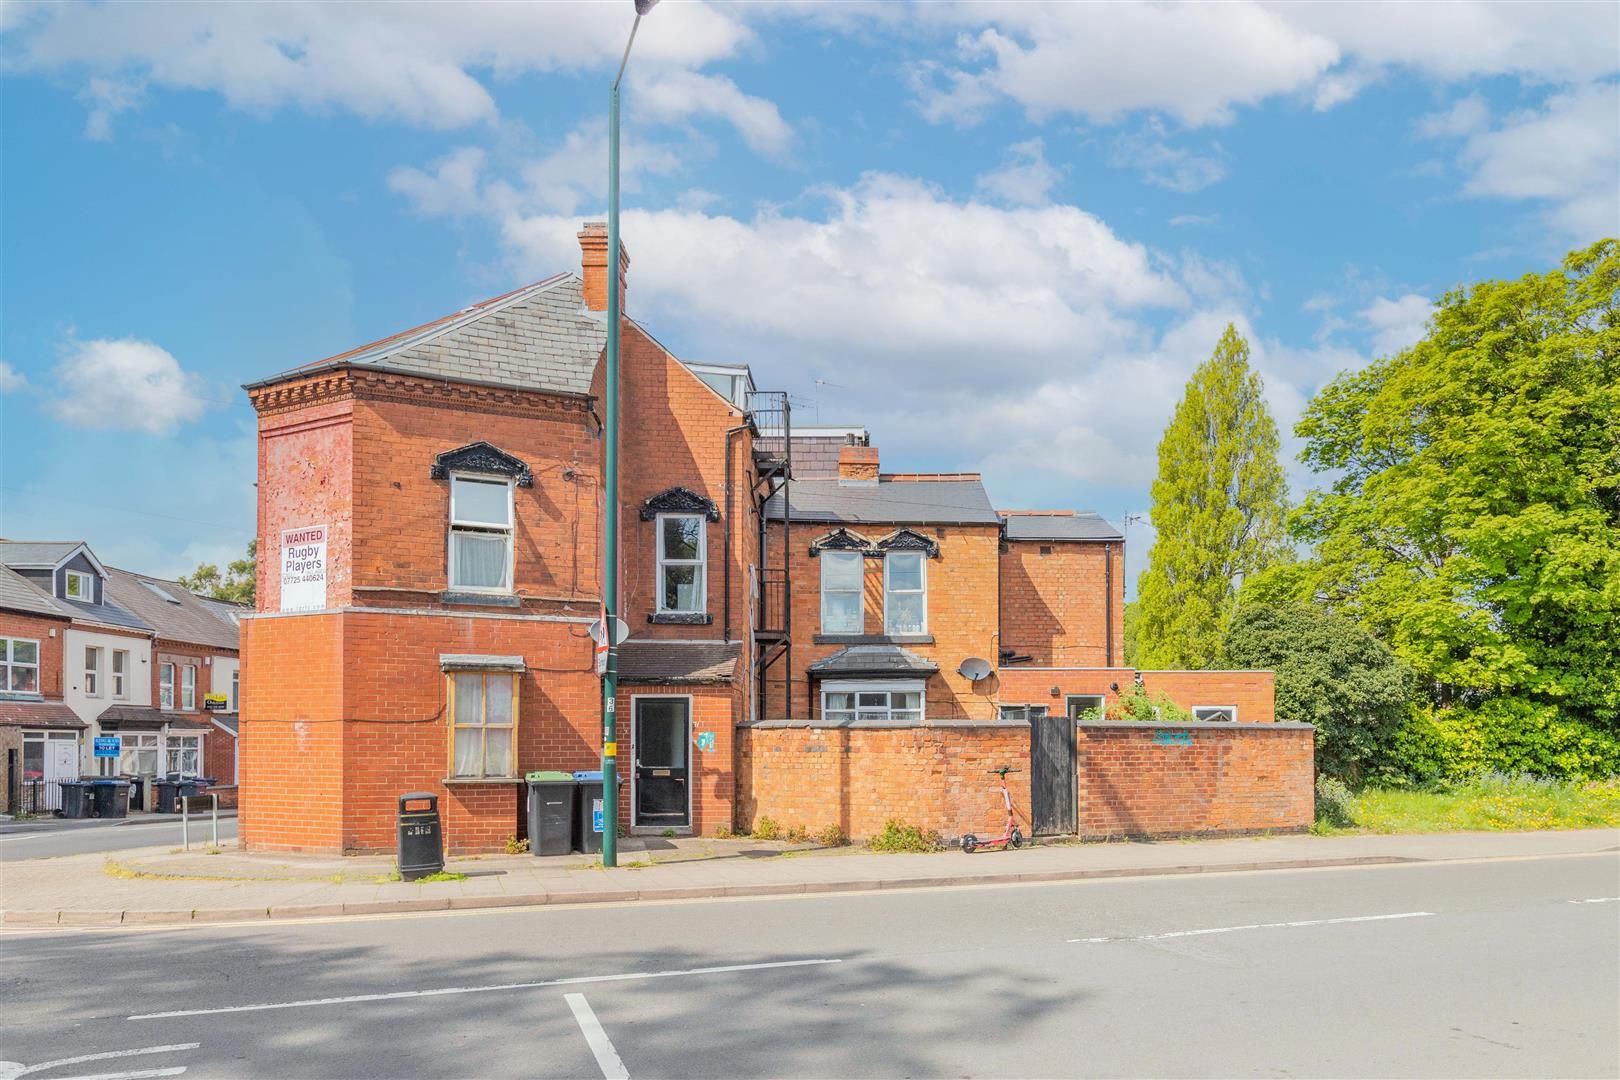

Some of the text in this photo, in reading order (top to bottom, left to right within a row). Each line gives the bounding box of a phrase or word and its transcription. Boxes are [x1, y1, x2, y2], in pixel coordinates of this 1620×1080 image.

[286, 530, 323, 544] WANTED
[288, 545, 320, 560] Rugby
[286, 559, 322, 573] Players
[283, 576, 300, 584] 07725
